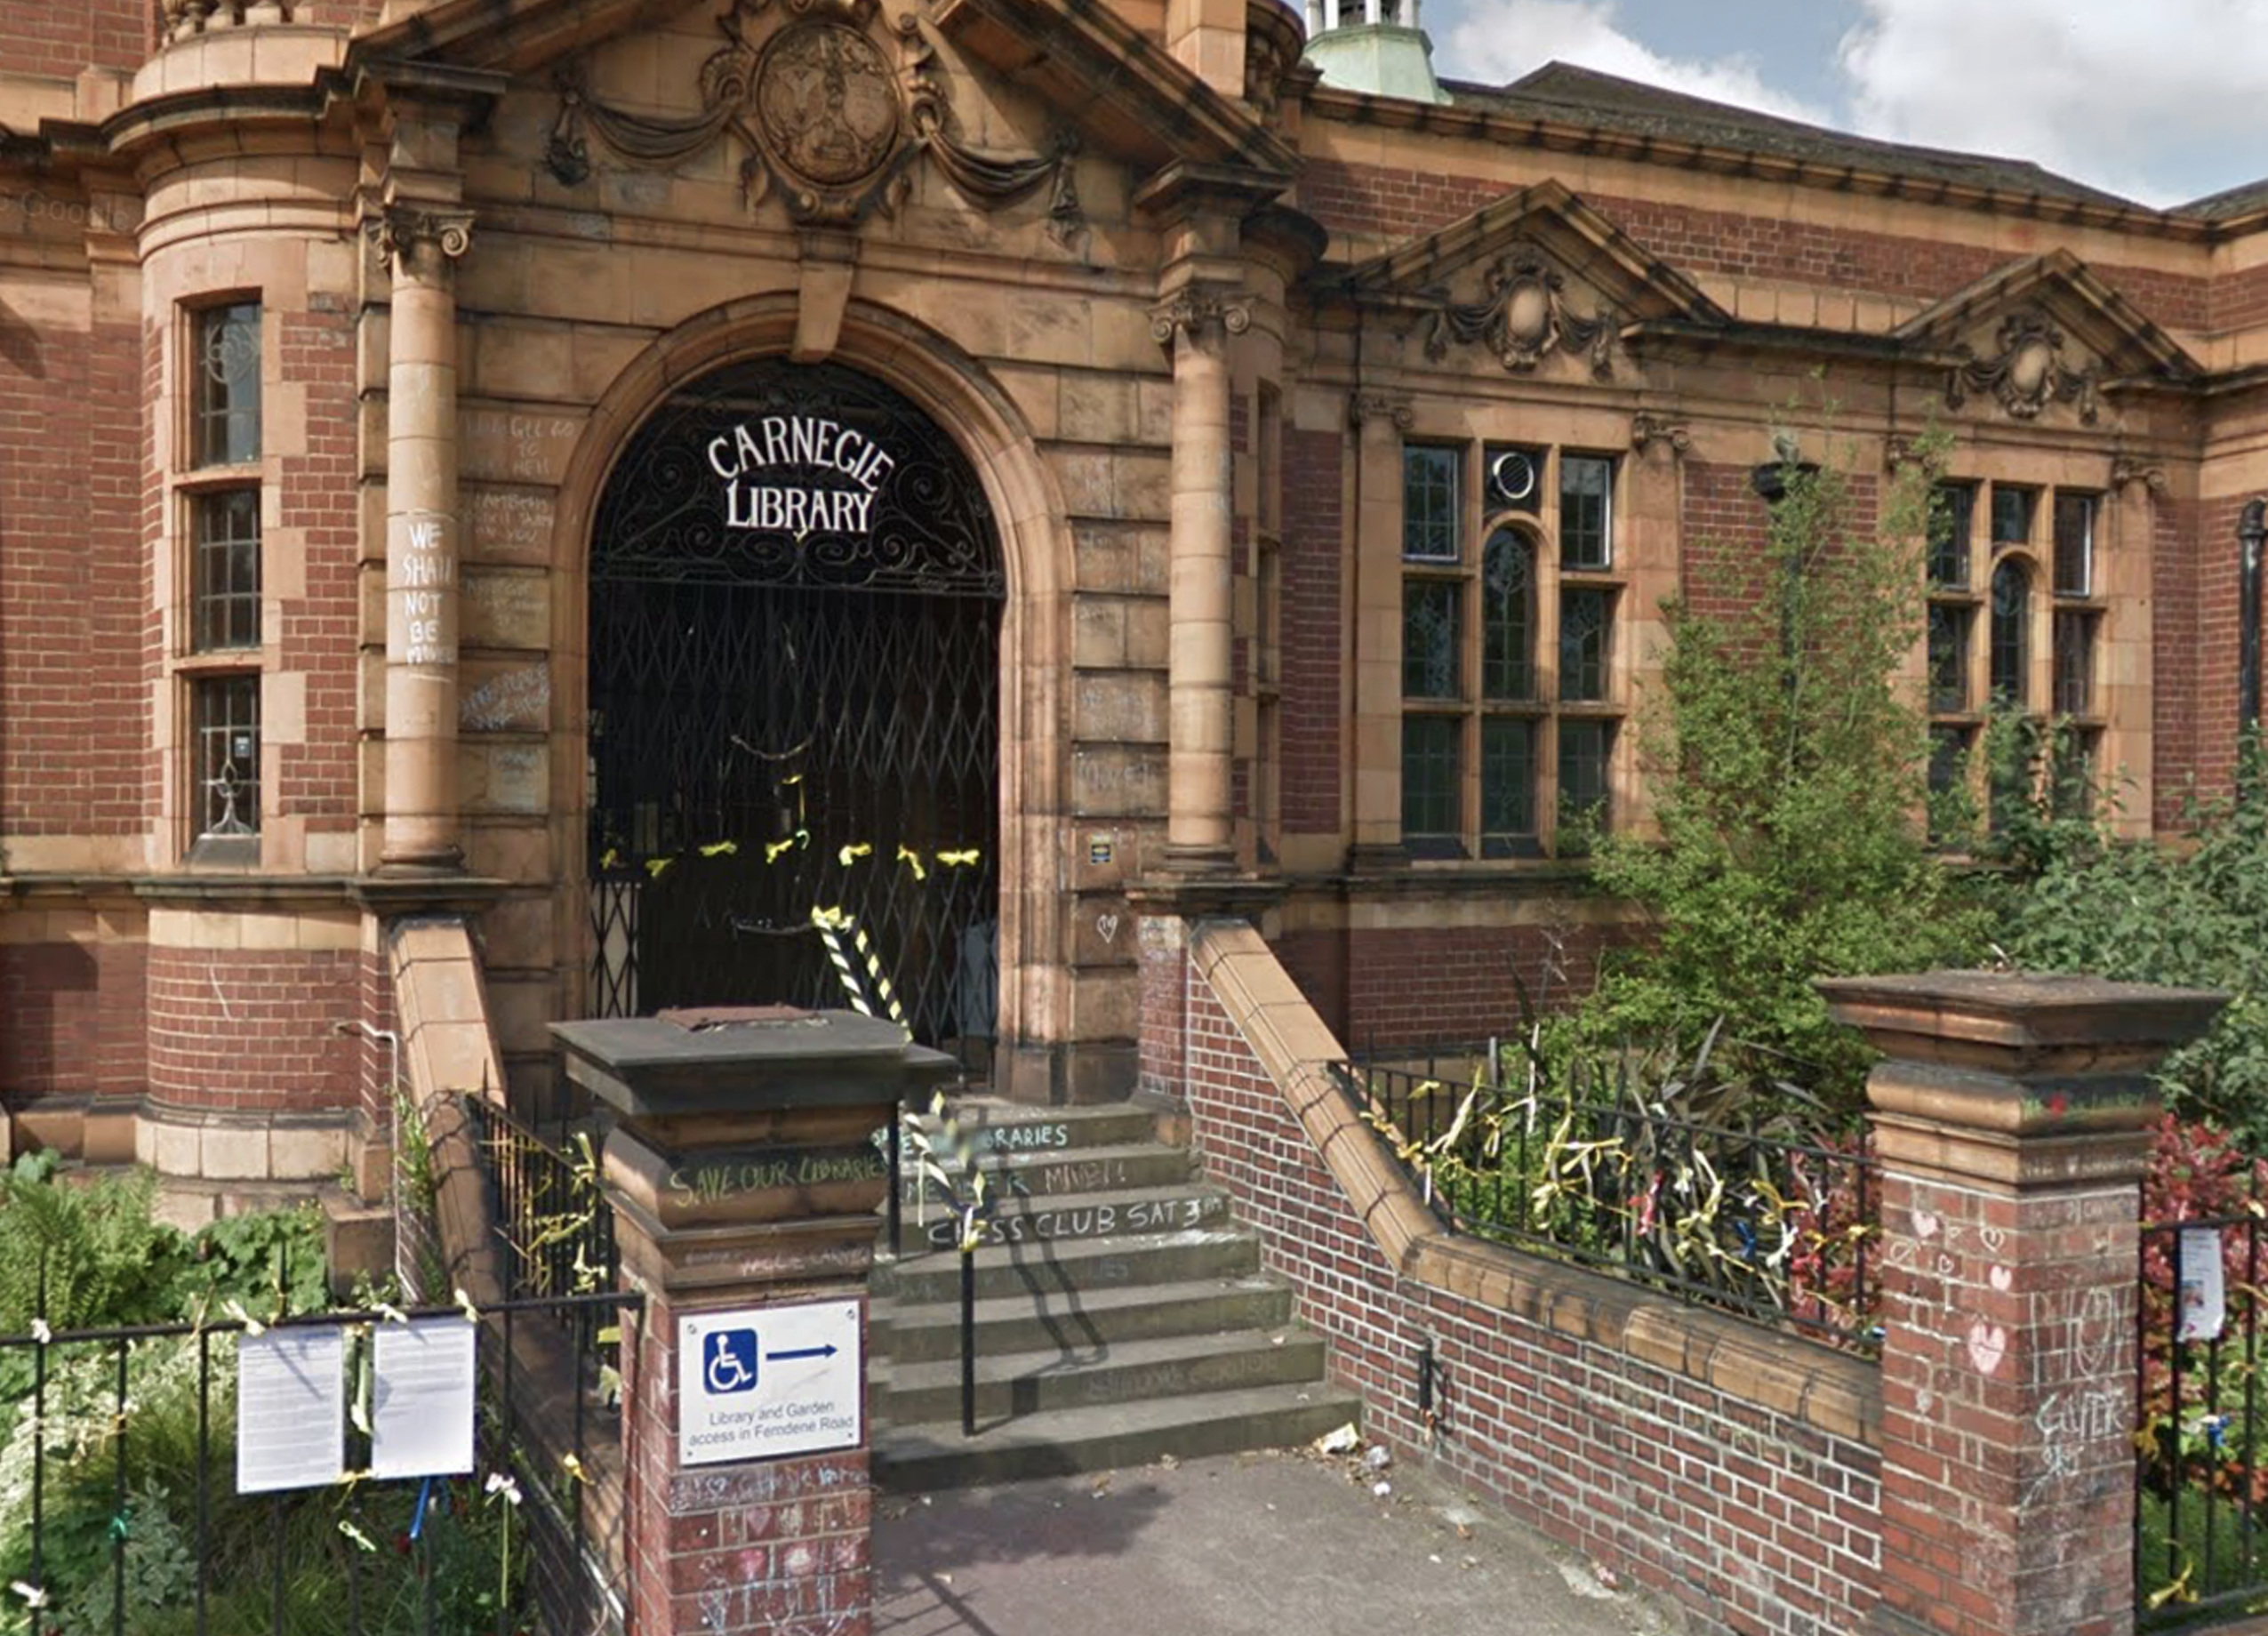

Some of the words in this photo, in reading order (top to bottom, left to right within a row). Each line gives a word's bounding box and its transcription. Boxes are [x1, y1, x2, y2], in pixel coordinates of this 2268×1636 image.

[709, 415, 894, 492] CARNEGIE
[726, 478, 873, 533] LIBRARY
[409, 523, 442, 550] WE
[405, 591, 442, 617] NOT
[410, 621, 439, 644] BE
[670, 1164, 734, 1207] SAVE
[740, 1159, 795, 1191] OUR
[1035, 1206, 1116, 1237] CLUB
[1126, 1201, 1178, 1229] SAT
[709, 1409, 756, 1425] Library
[758, 1404, 784, 1420] and
[786, 1399, 835, 1417] Garden
[688, 1429, 736, 1446] access
[739, 1427, 751, 1439] in
[820, 1415, 854, 1432] Road
